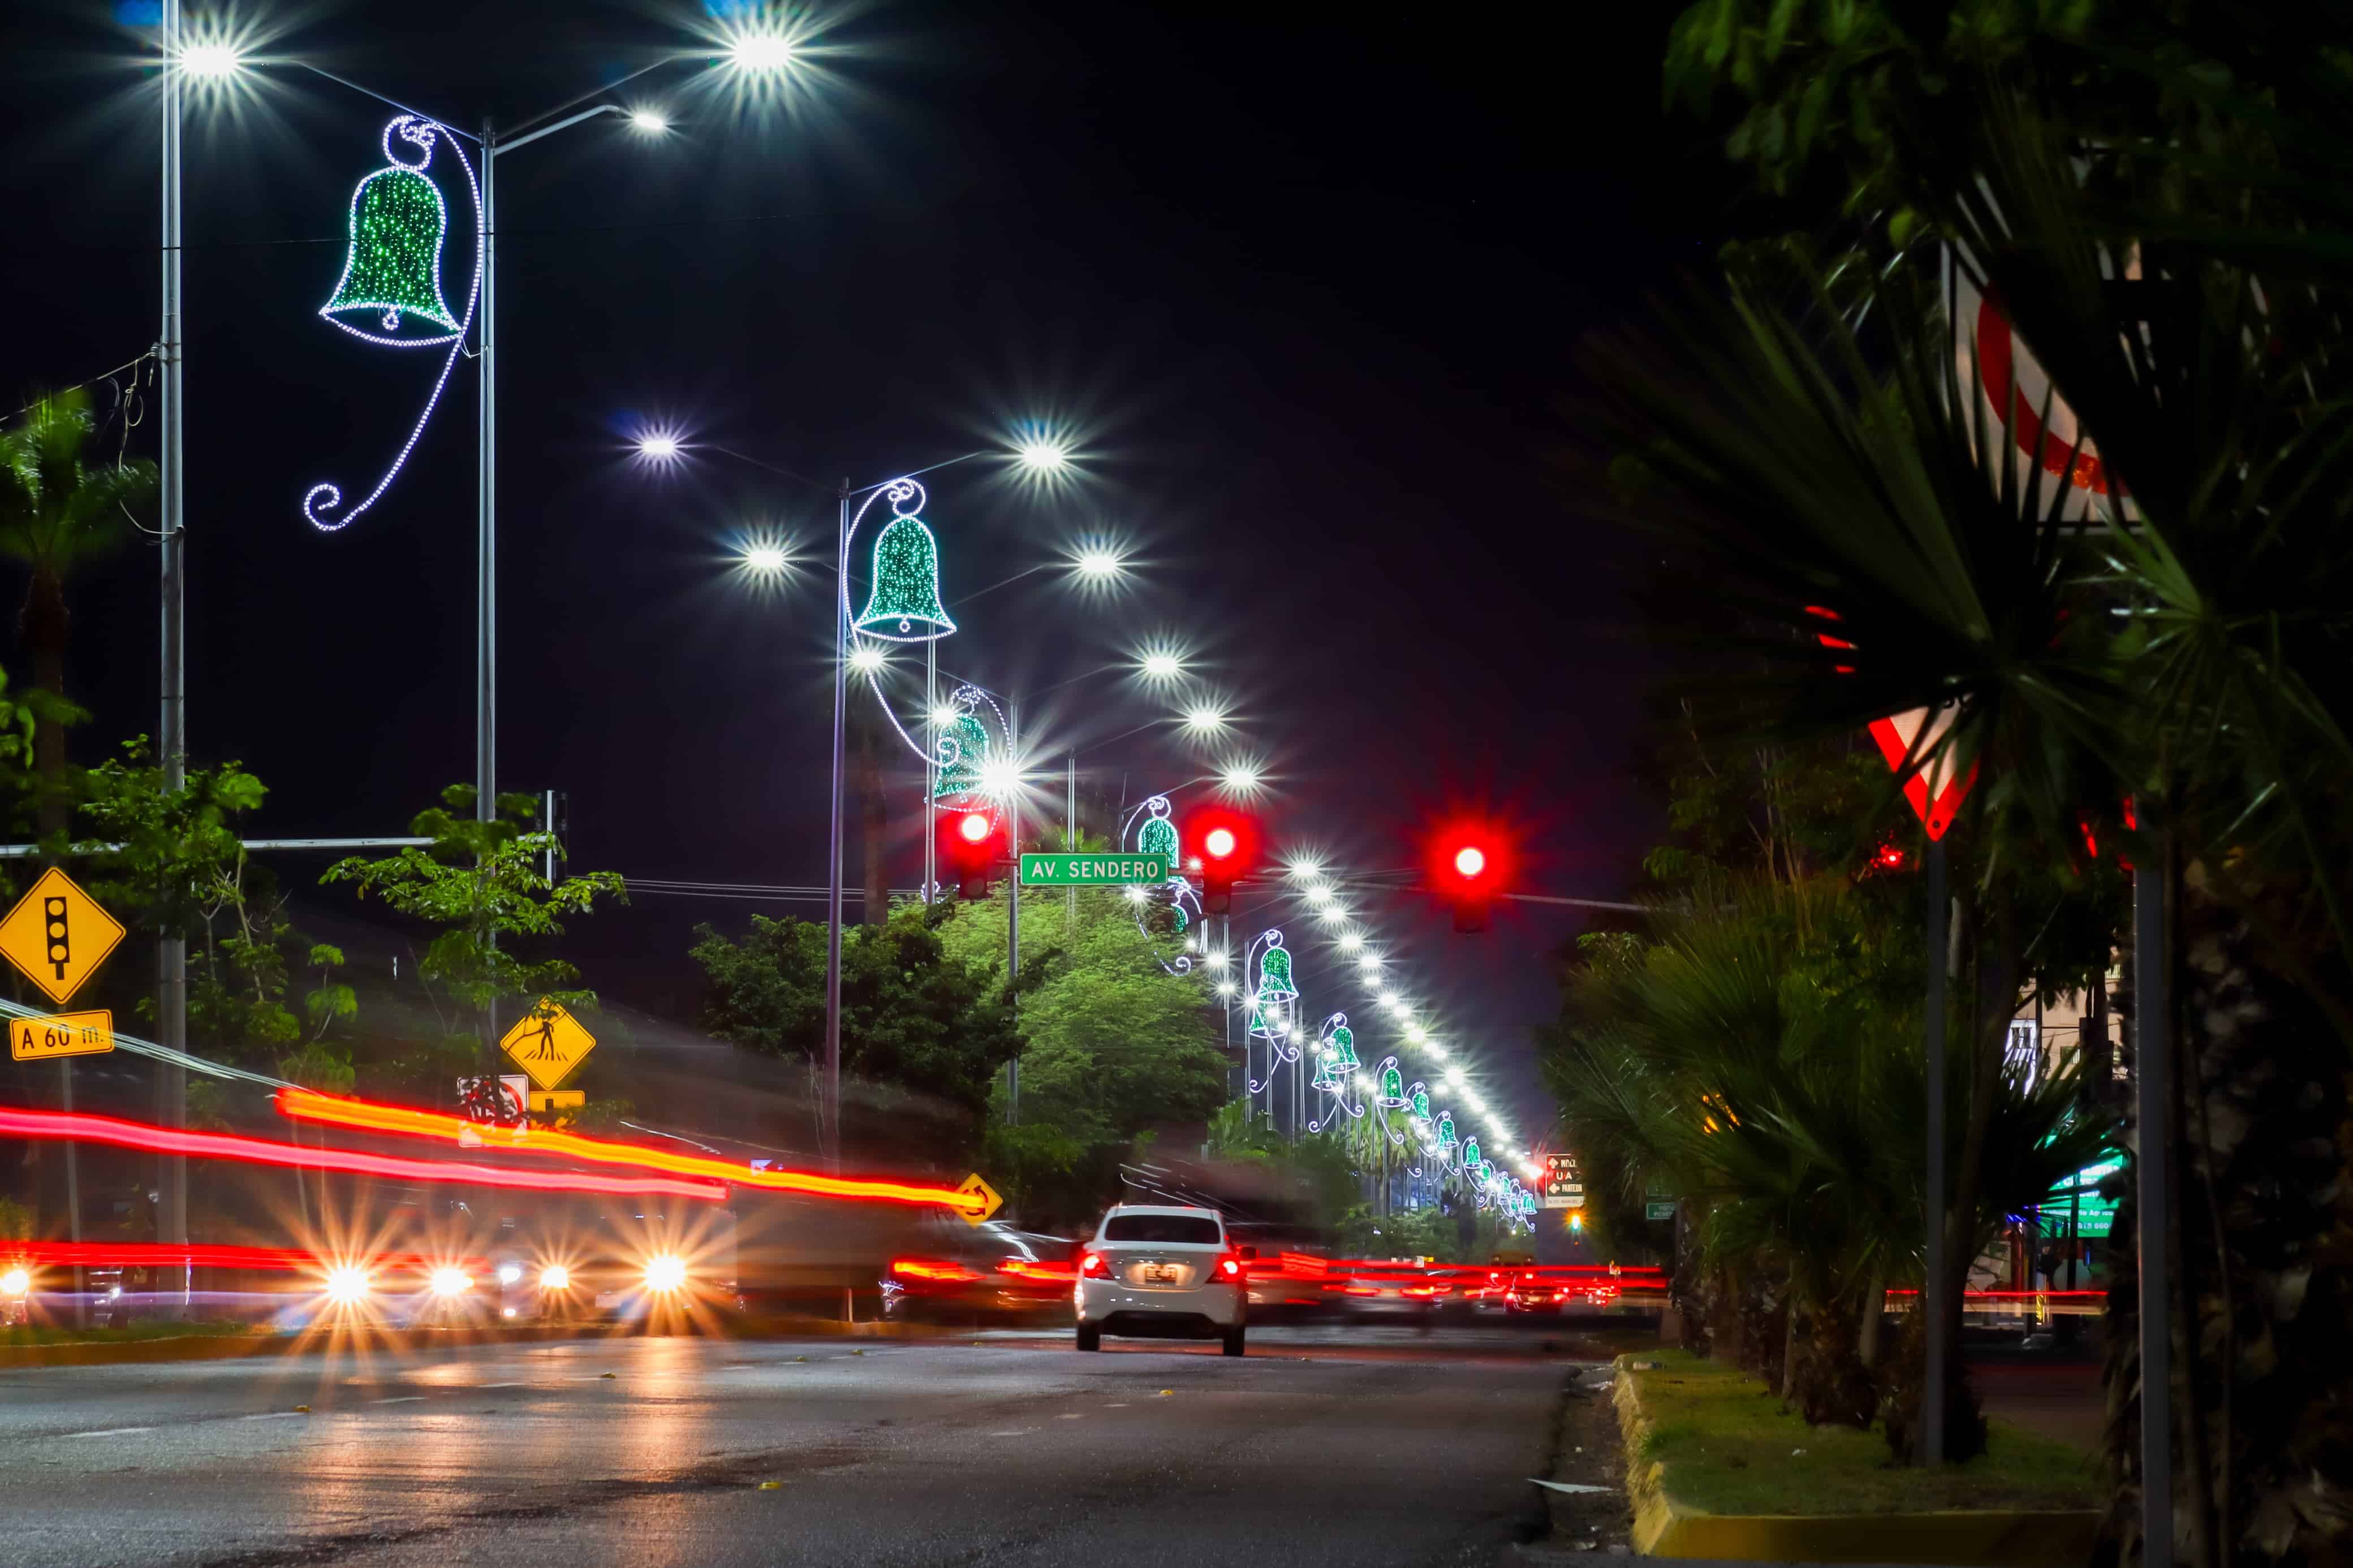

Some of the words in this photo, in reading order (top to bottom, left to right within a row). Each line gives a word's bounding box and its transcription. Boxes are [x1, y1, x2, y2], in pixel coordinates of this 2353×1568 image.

[1031, 861, 1059, 878] AV.
[1068, 861, 1159, 878] SENDERO
[22, 1027, 35, 1050] A
[45, 1022, 70, 1048] 60
